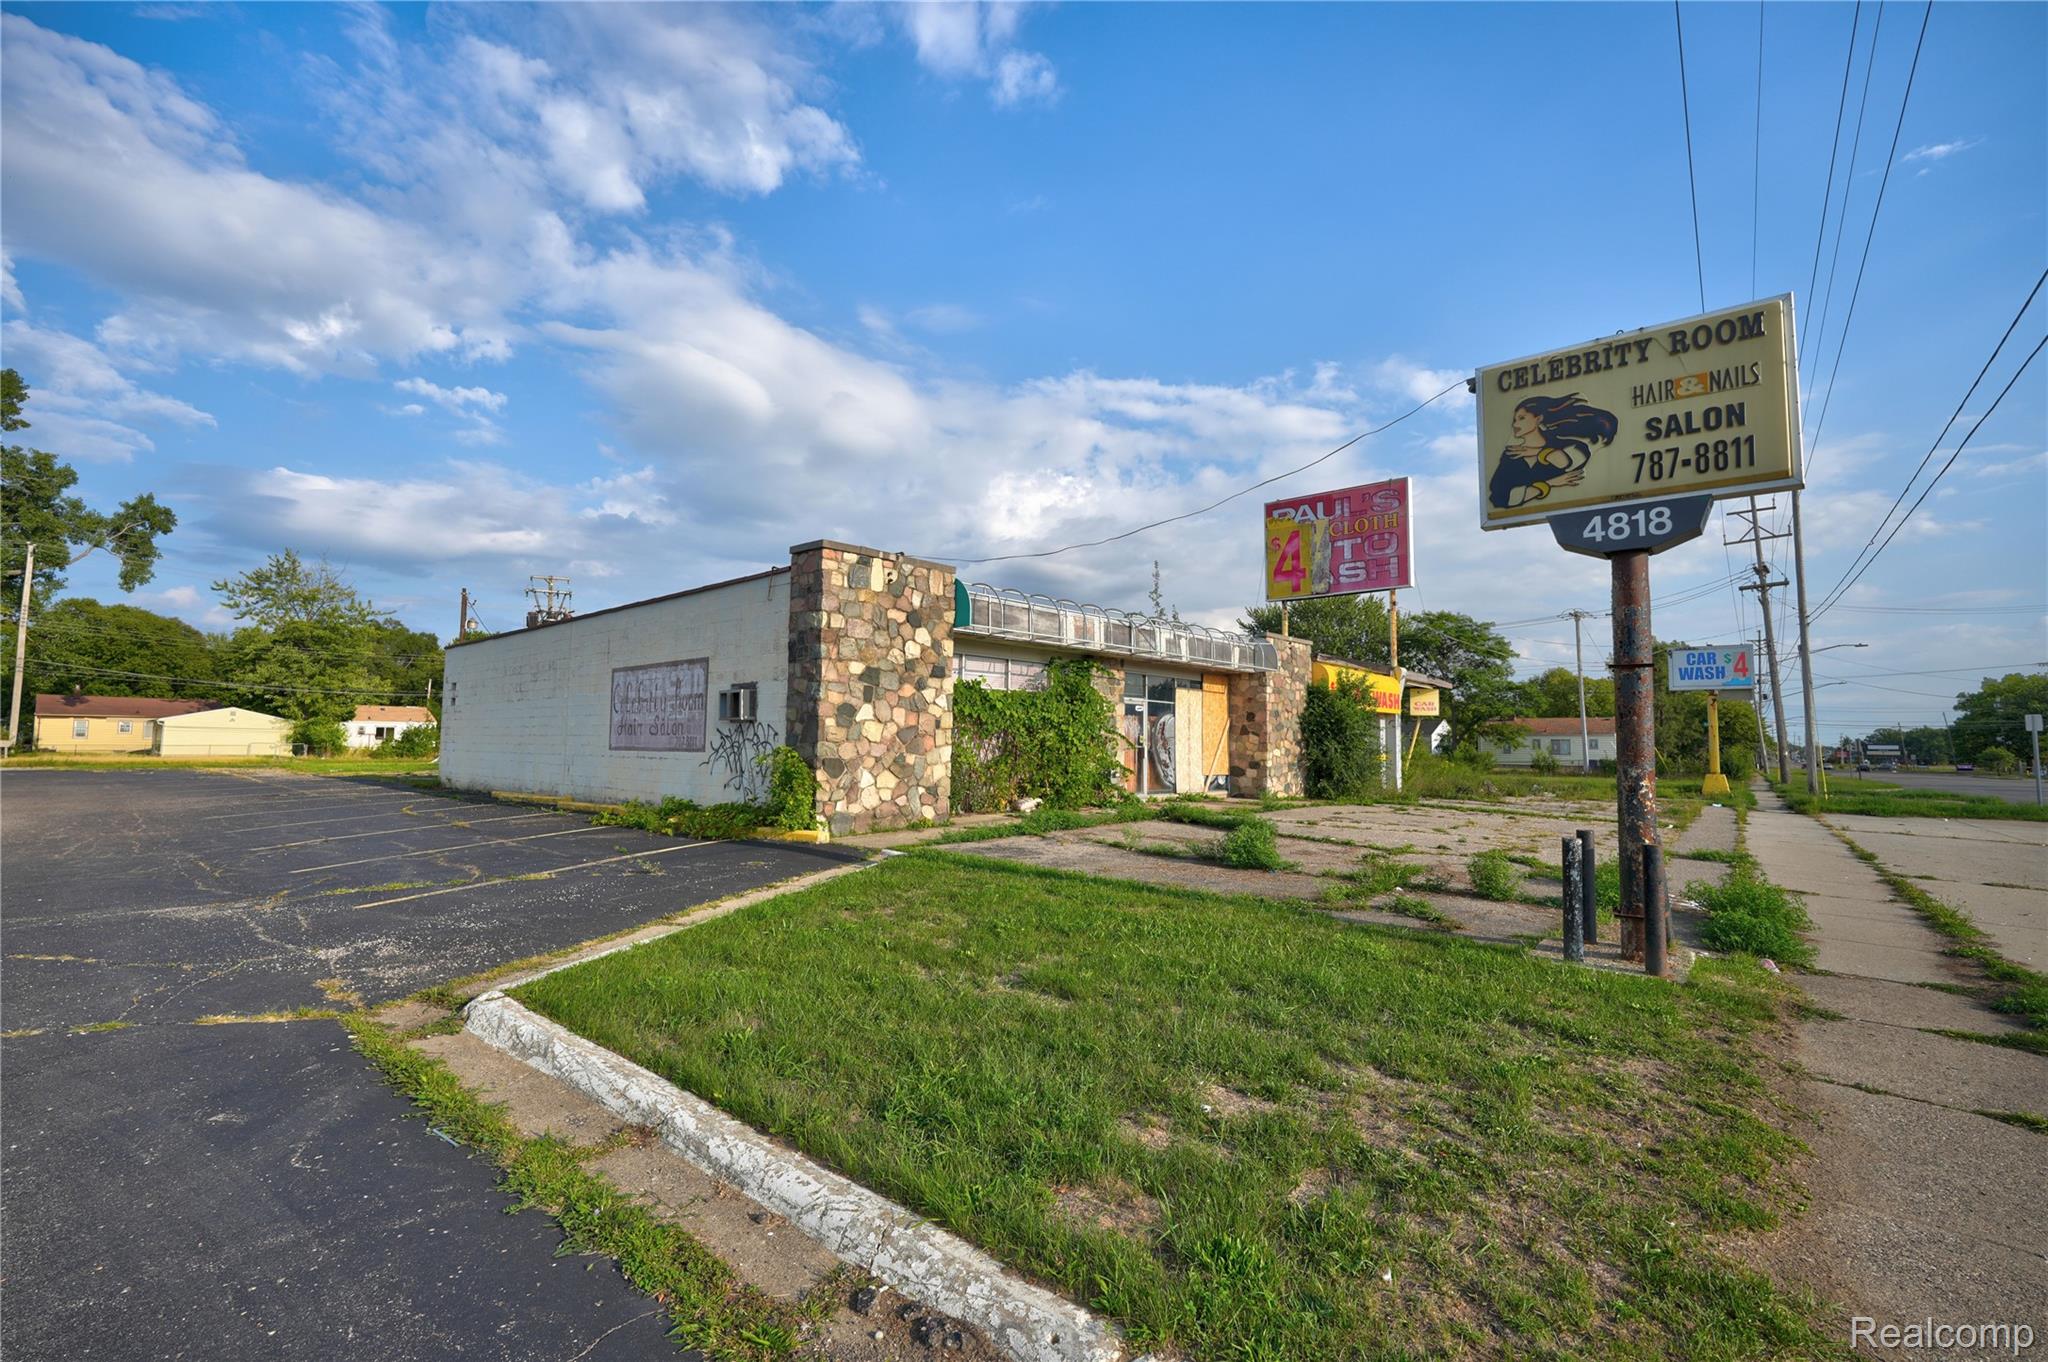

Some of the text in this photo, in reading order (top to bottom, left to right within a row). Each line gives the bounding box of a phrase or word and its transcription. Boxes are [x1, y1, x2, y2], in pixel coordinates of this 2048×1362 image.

[1497, 310, 1767, 393] CELEBRITY ROOM
[1632, 378, 1675, 407] HAIR
[1709, 361, 1761, 392] NAILS
[1645, 402, 1747, 442] SALON
[1632, 434, 1756, 484] 787-8811
[1272, 488, 1402, 523] PAUL'S
[1329, 512, 1399, 537] CLOTH
[1582, 506, 1673, 543] 4818
[1679, 666, 1726, 680] WASH
[1686, 651, 1717, 666] CAR
